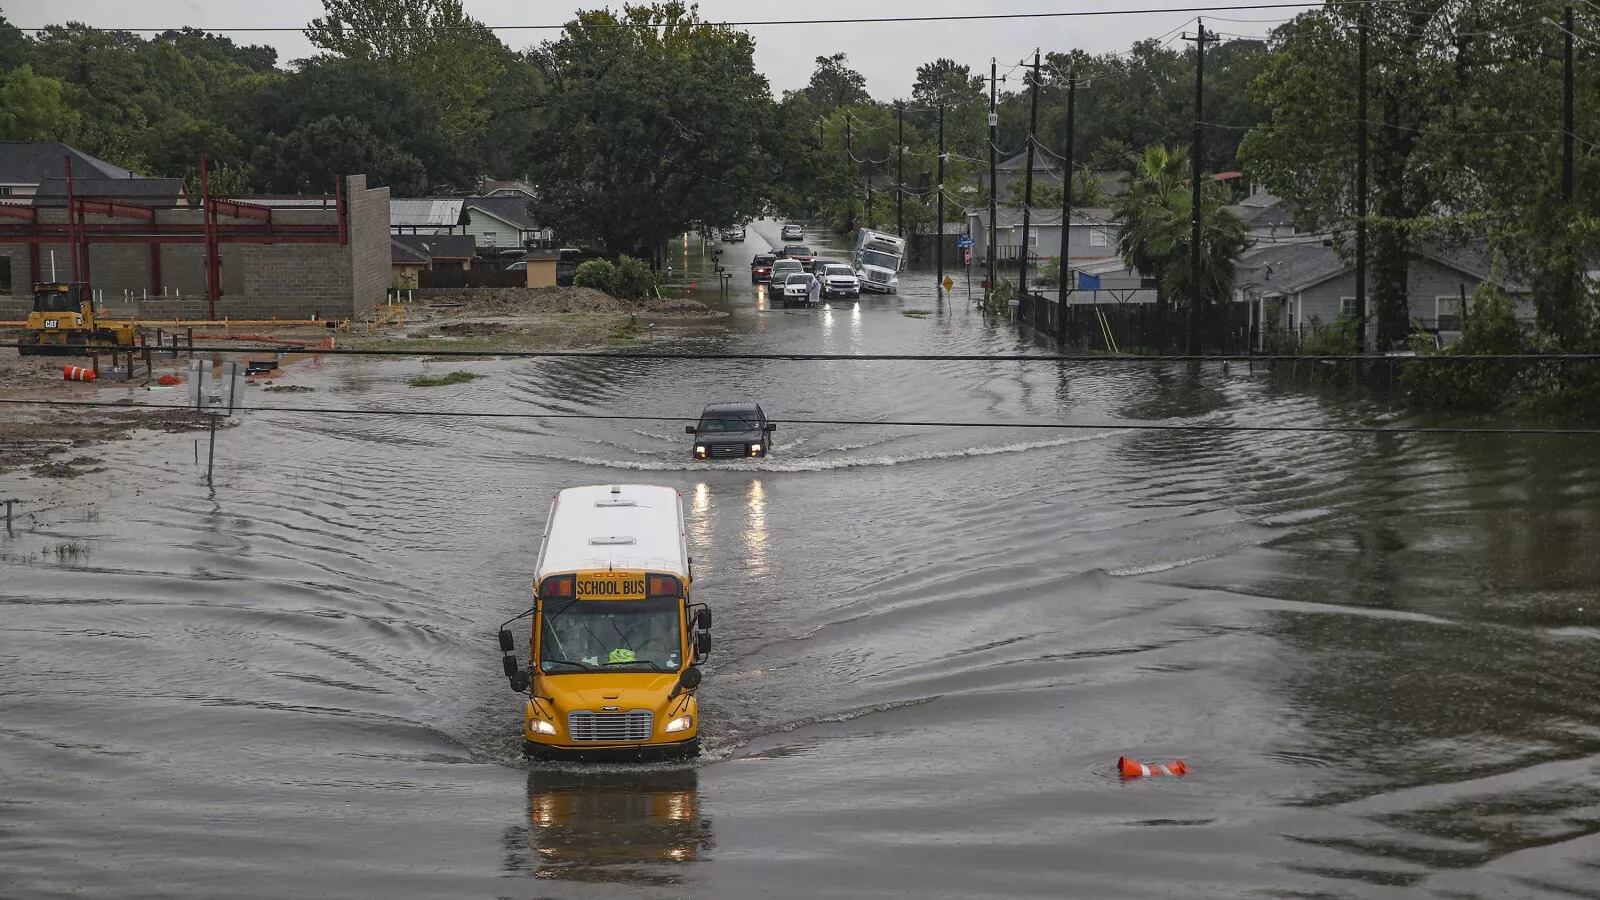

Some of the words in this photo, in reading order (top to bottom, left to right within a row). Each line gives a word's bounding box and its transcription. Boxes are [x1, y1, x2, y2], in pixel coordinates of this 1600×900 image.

[45, 320, 58, 328] CAT
[577, 581, 620, 595] SCHOOL
[623, 581, 645, 595] BUS
